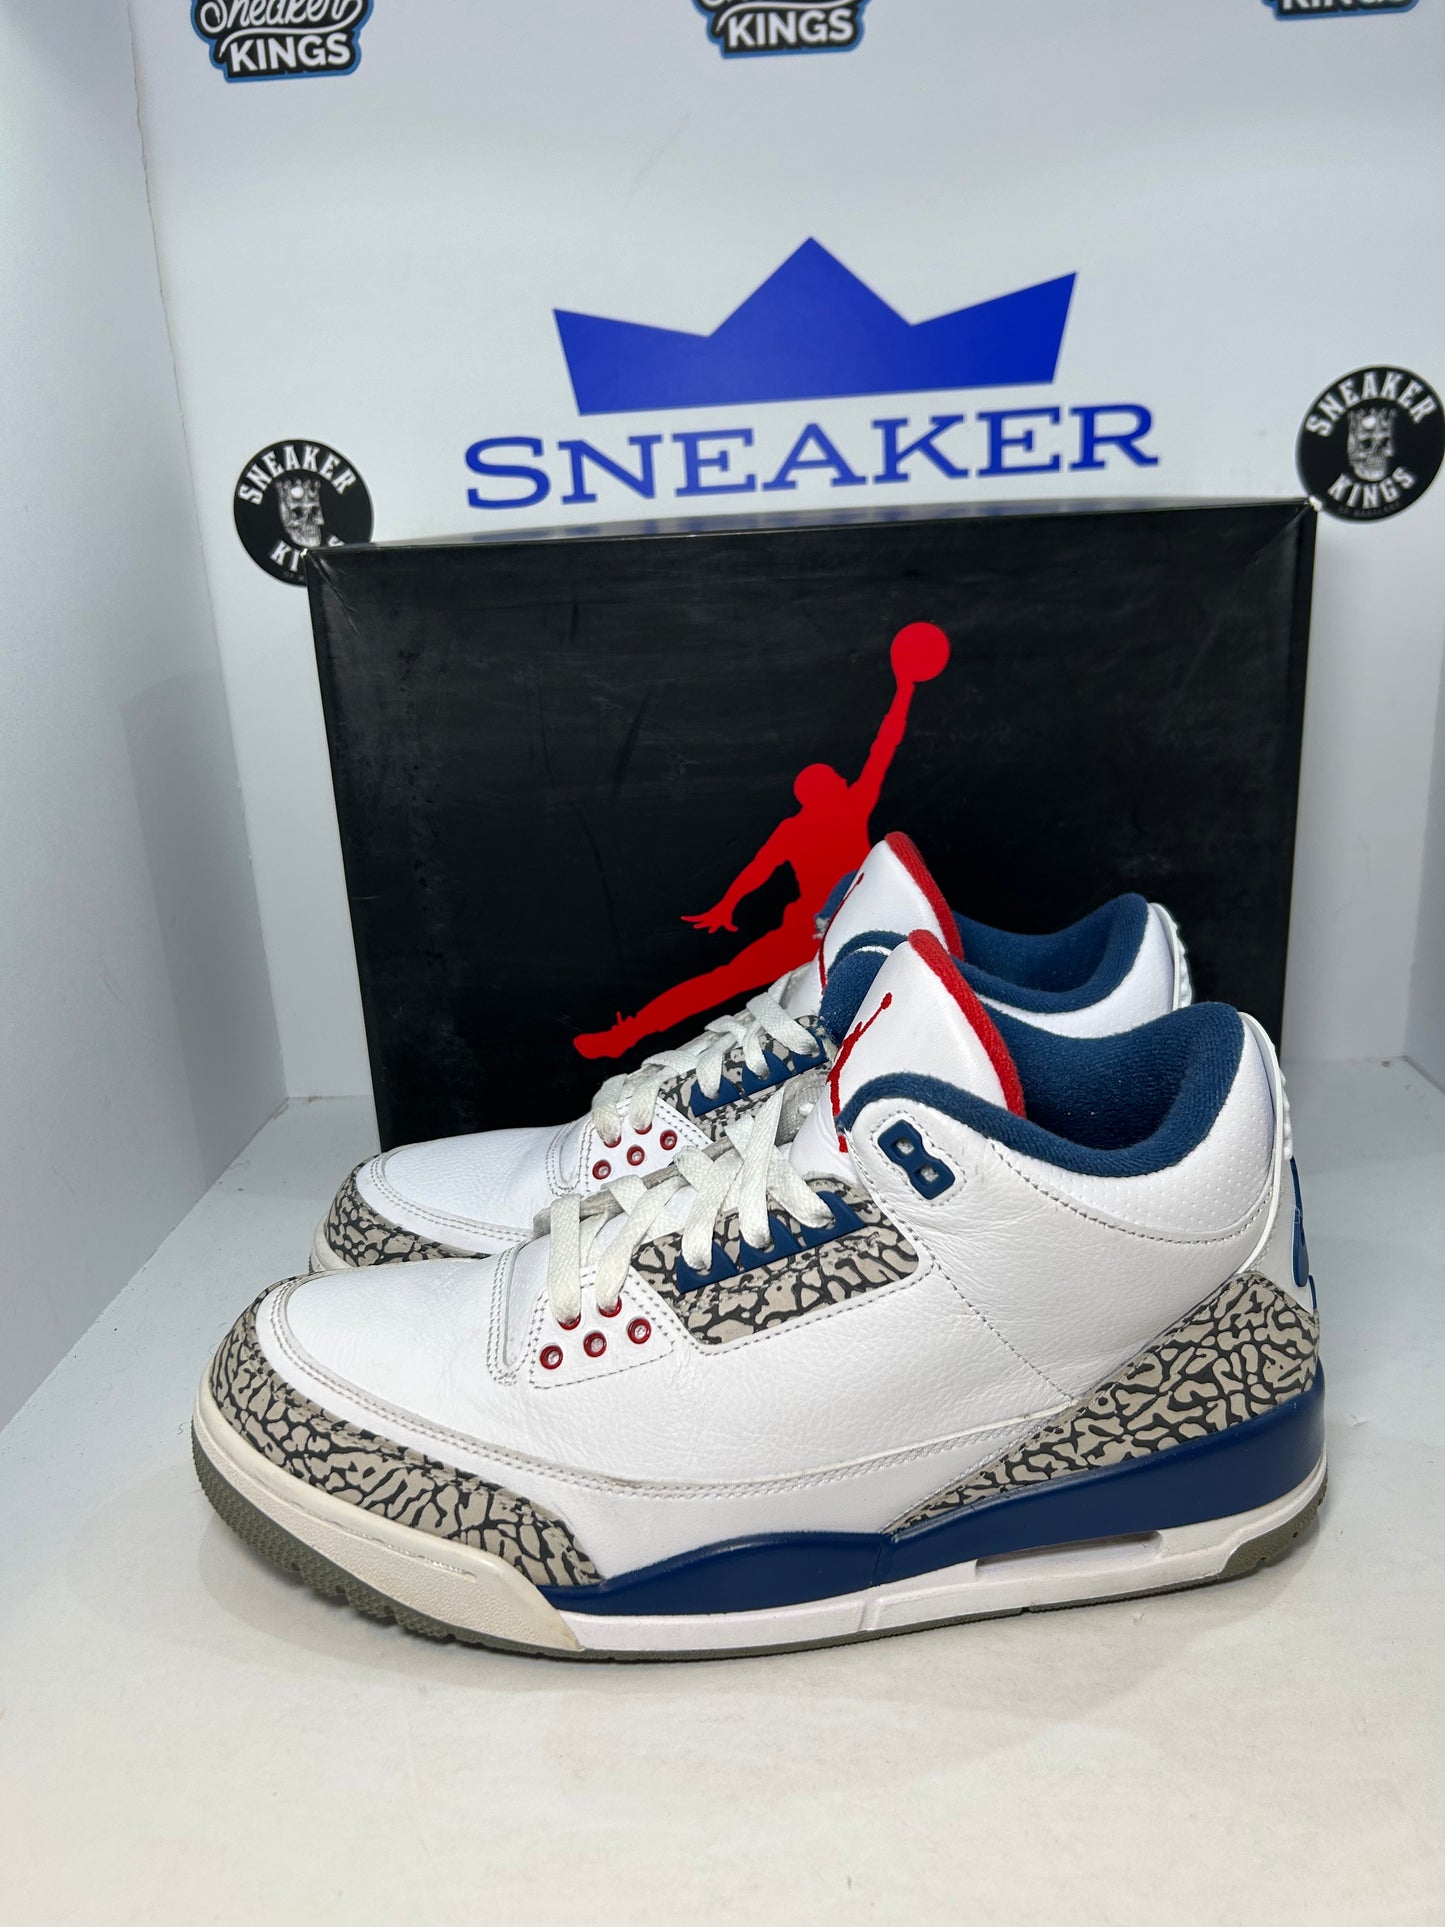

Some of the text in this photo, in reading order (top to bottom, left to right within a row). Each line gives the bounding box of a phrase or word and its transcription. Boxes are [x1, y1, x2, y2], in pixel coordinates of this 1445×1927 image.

[229, 32, 350, 73] KINGS
[727, 8, 854, 48] KINGS
[1305, 371, 1437, 437] SNEAKER
[238, 444, 357, 506] SNEAKER
[464, 403, 1159, 510] SNEAKER
[1327, 466, 1417, 510] KINGS
